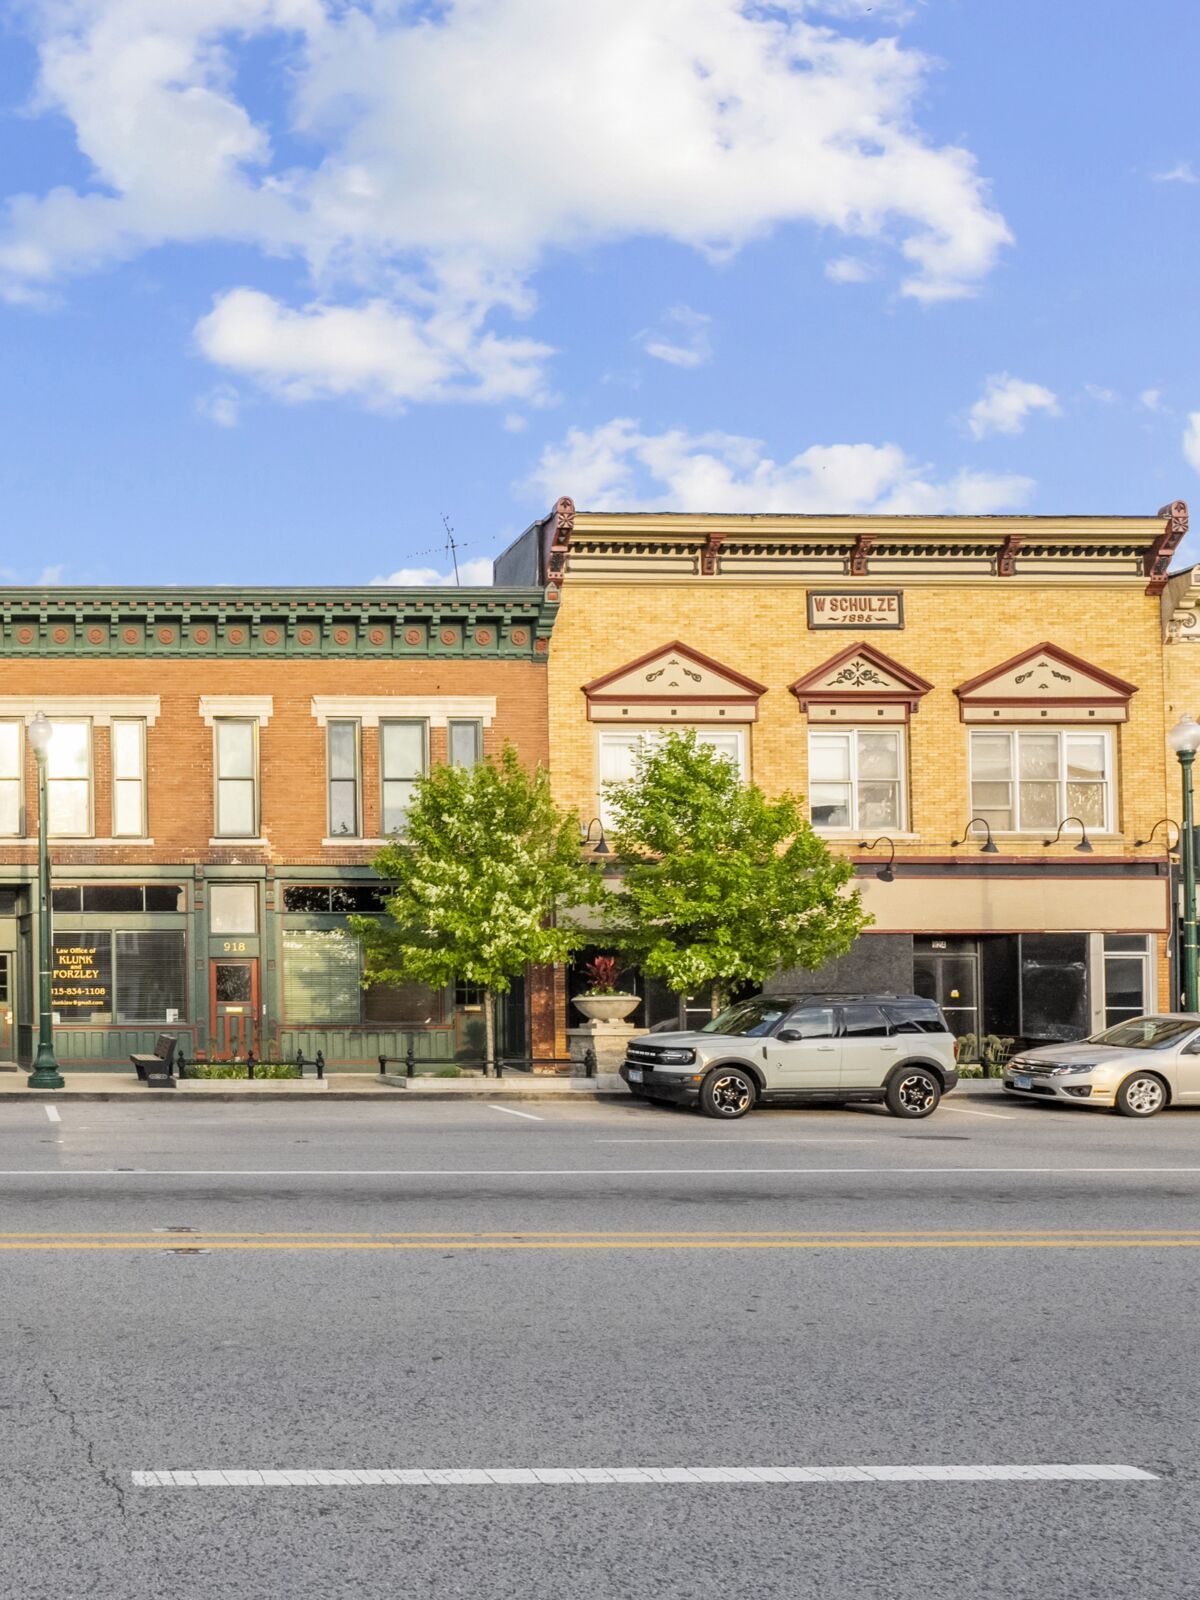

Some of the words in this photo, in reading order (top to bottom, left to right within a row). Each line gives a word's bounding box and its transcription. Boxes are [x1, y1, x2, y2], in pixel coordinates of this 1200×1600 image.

[814, 598, 826, 612] W
[830, 597, 896, 612] SCHULZE
[223, 942, 246, 952] 918
[59, 955, 93, 965] KLUNK
[53, 969, 100, 979] FORZLEY
